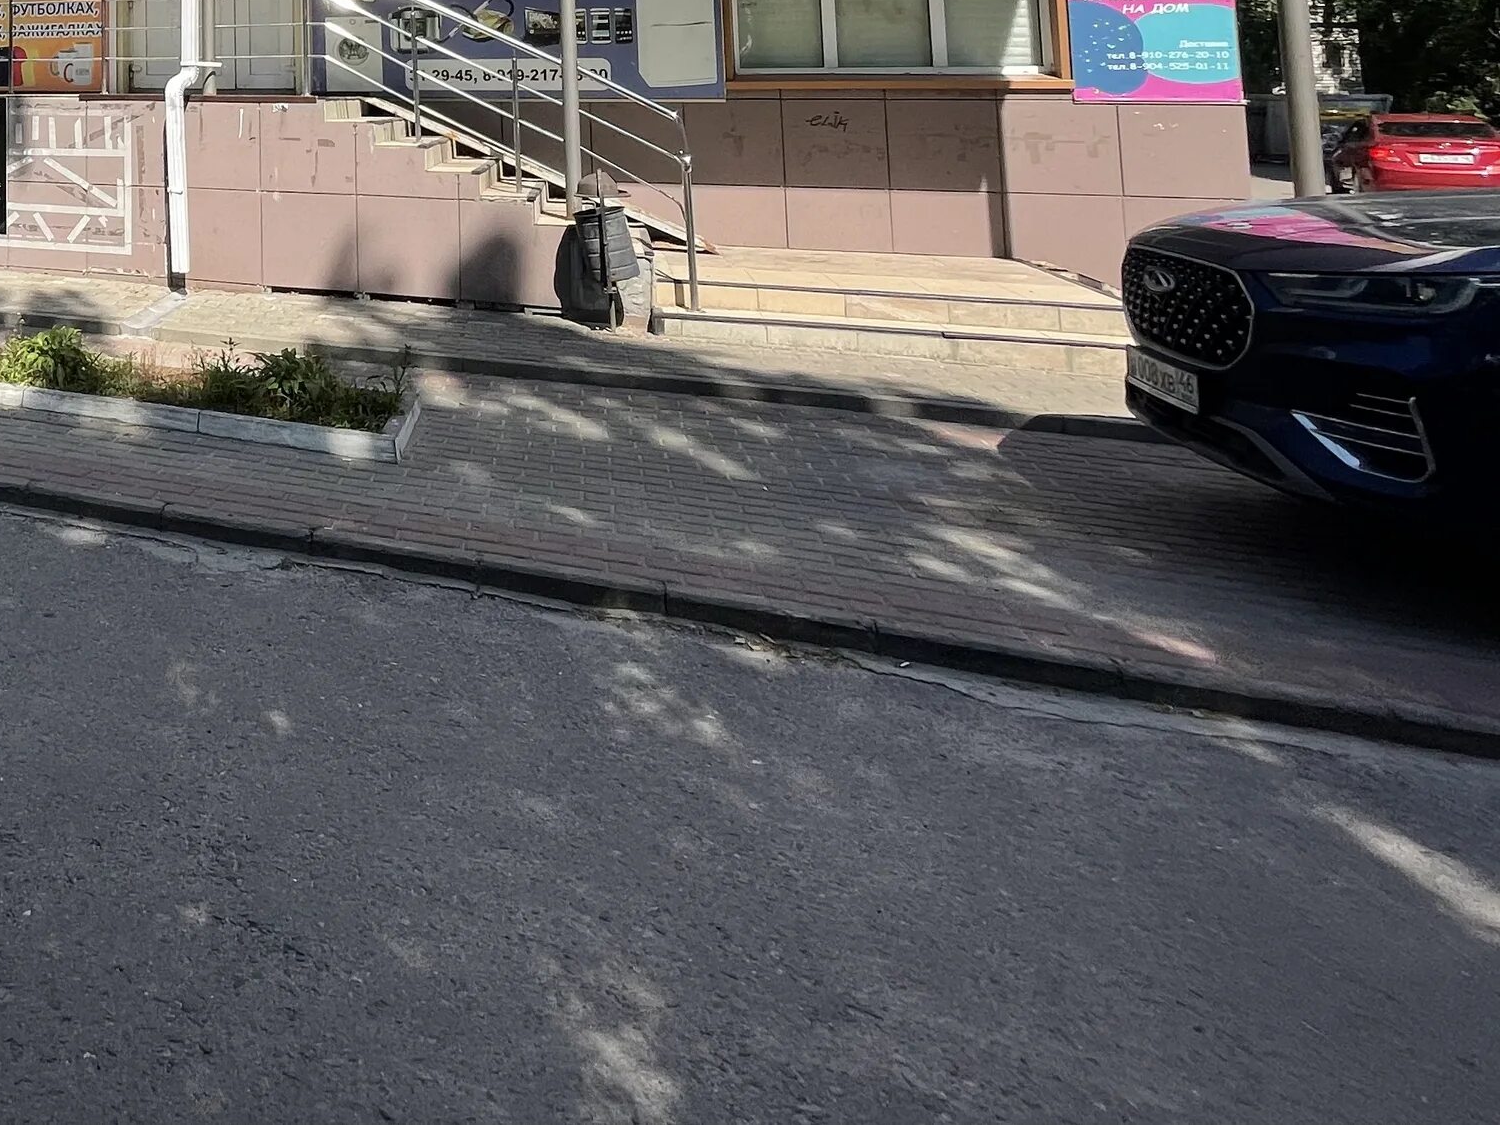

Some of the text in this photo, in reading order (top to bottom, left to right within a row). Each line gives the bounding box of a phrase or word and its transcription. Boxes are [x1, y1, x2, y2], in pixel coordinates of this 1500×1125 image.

[11, 1, 99, 16] ФУТБОЛКАХ,
[1122, 3, 1189, 15] НА ДОМ
